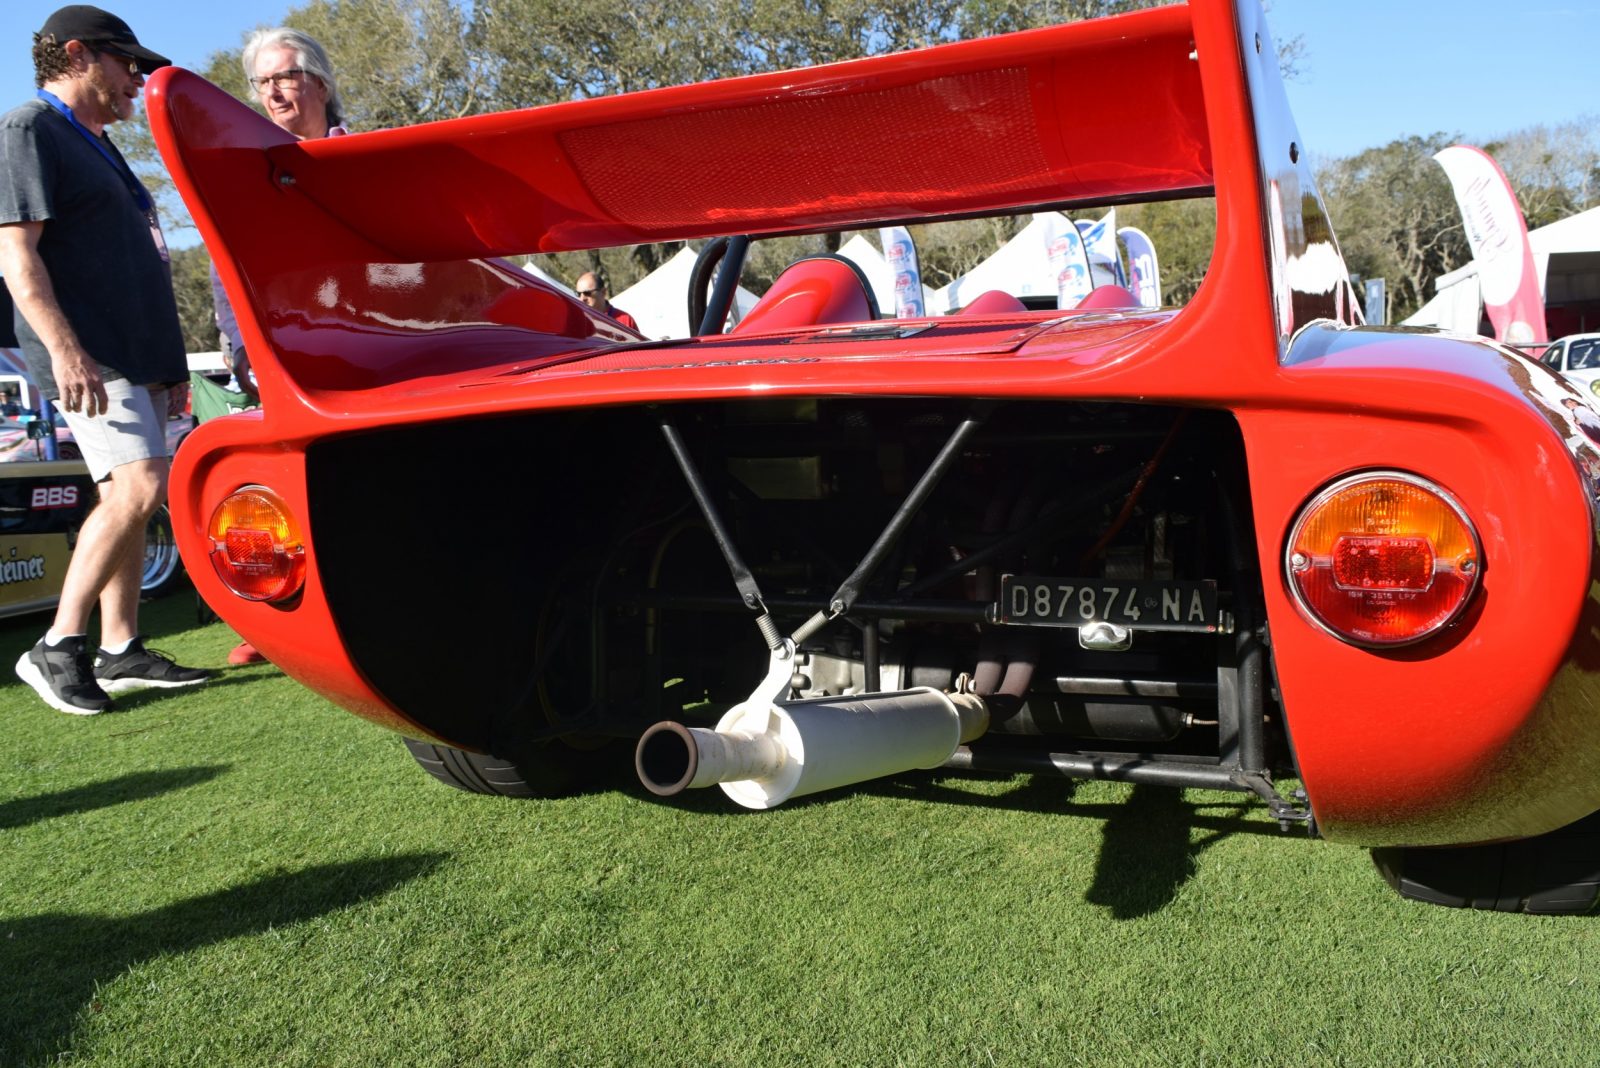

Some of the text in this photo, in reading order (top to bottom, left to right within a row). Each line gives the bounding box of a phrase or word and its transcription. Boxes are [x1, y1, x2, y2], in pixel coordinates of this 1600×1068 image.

[31, 485, 78, 509] BBS
[1012, 585, 1205, 622] D87874 NA
